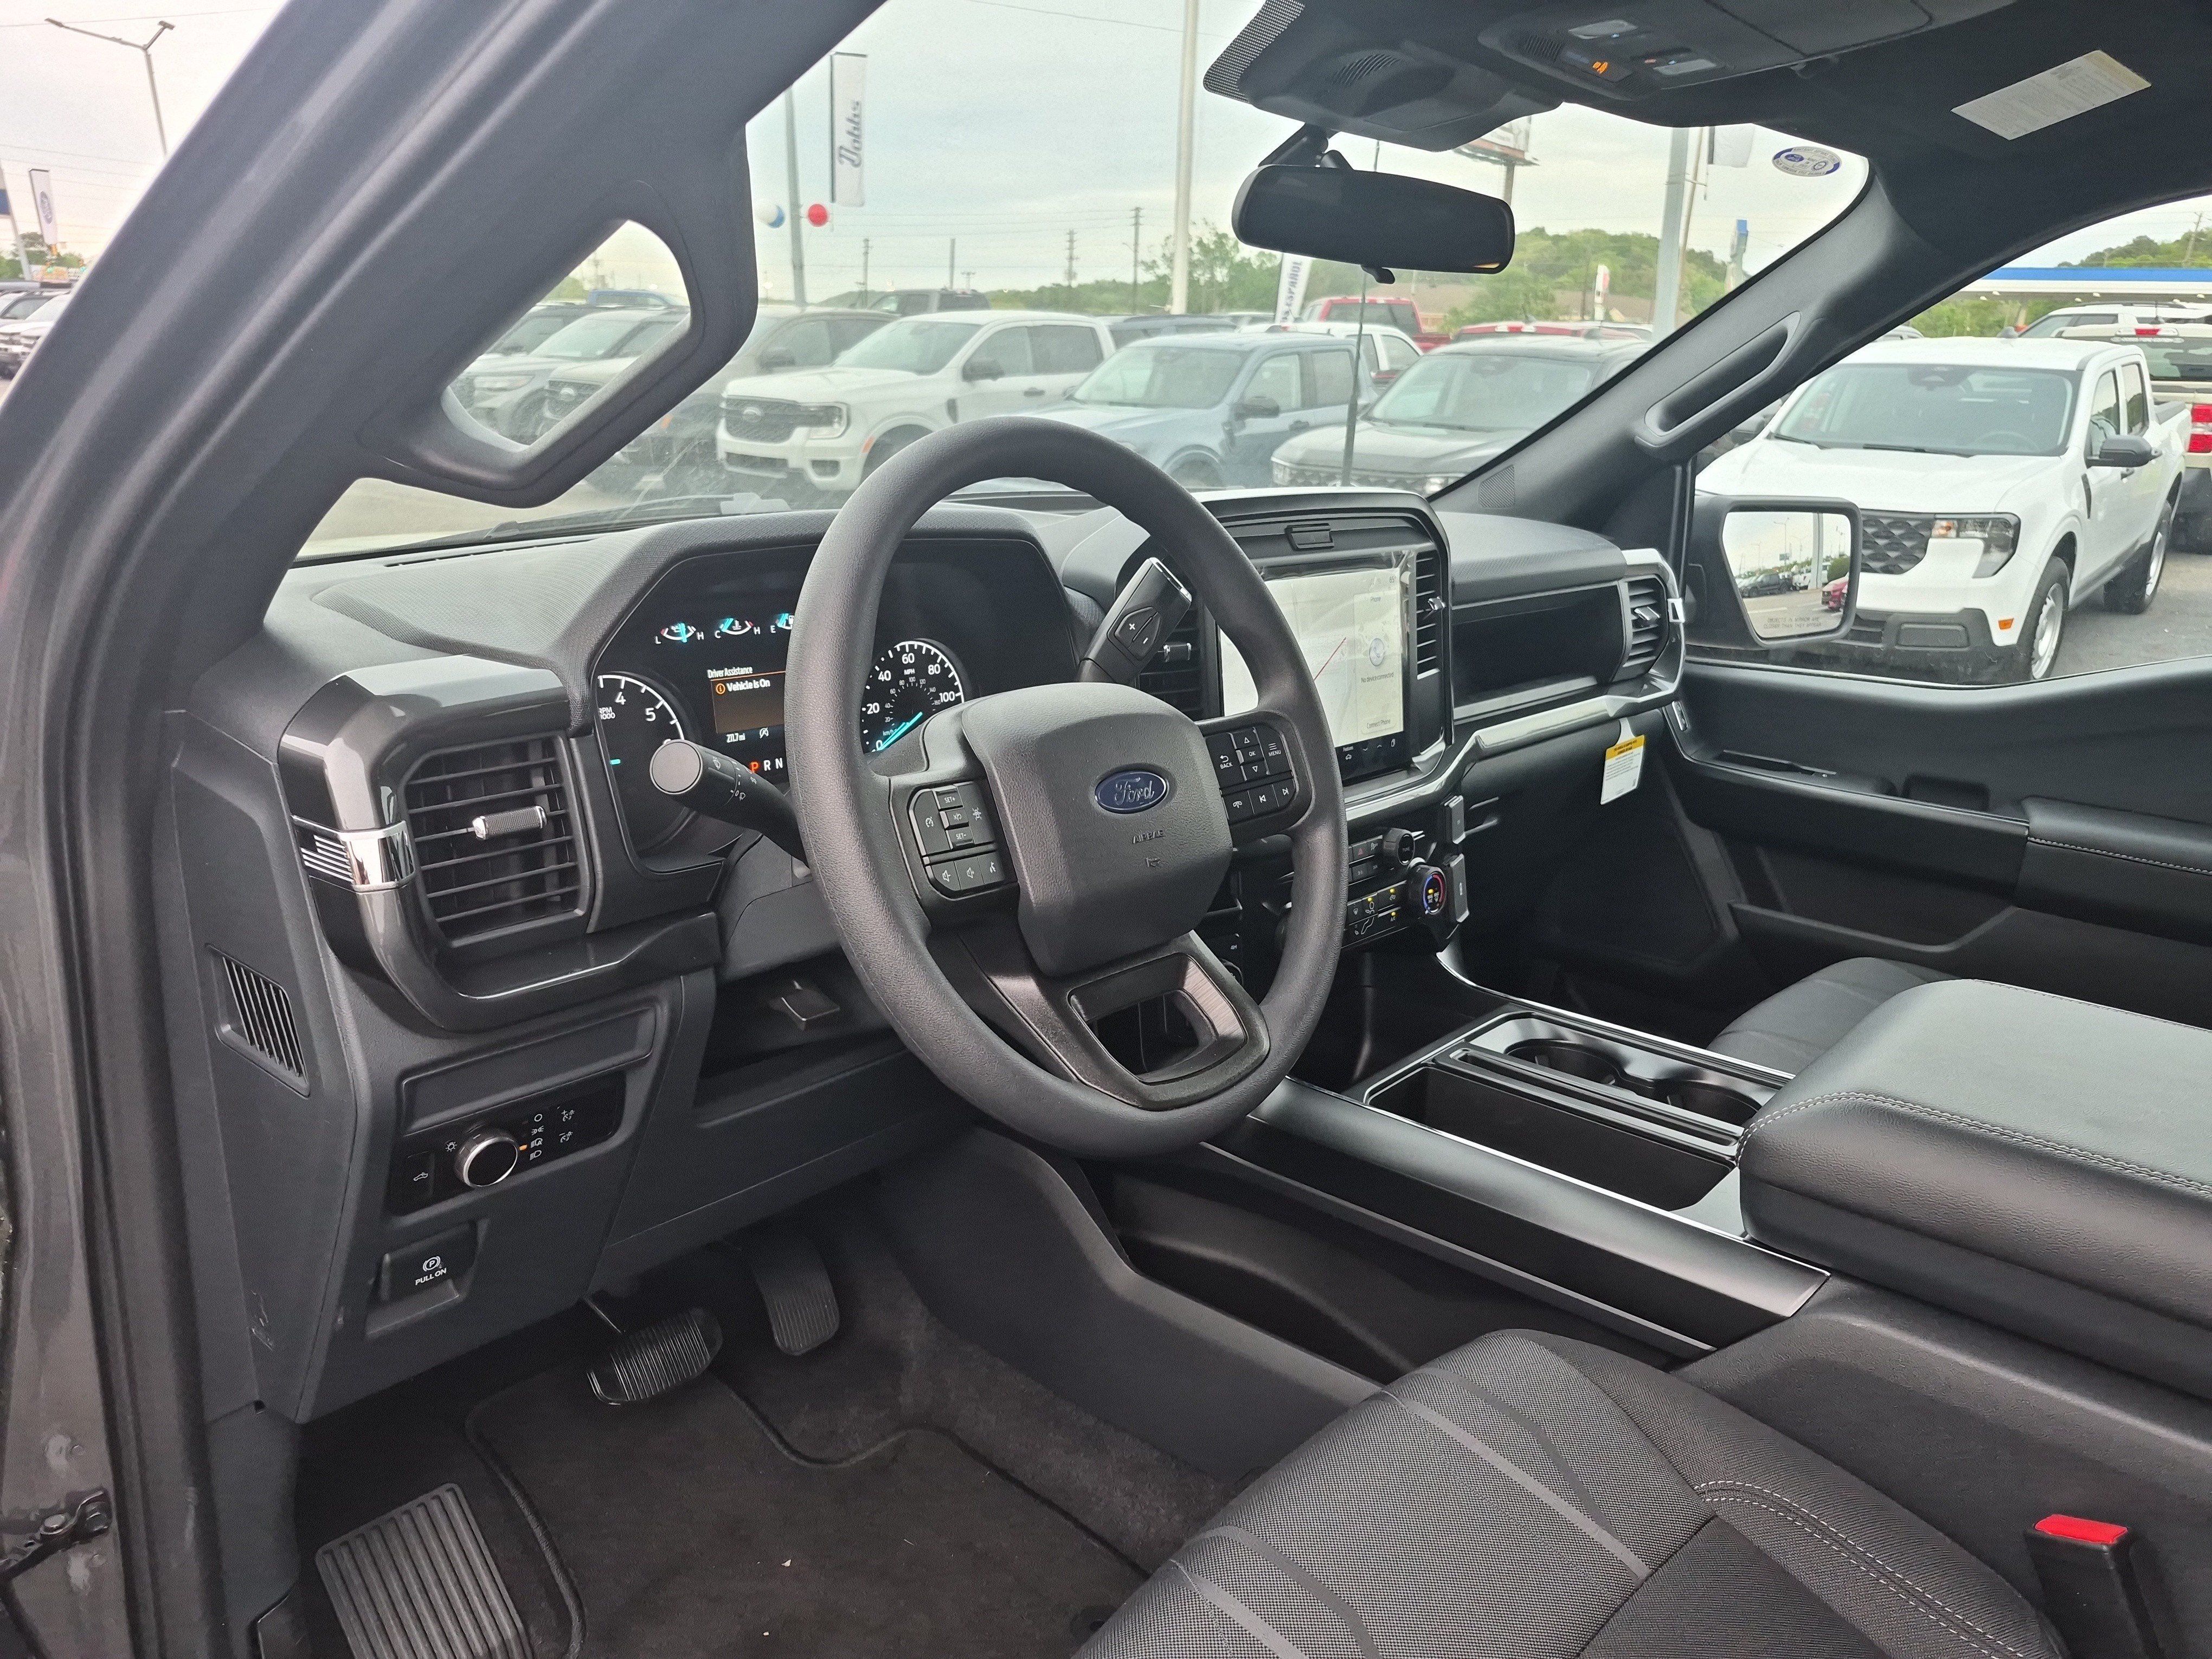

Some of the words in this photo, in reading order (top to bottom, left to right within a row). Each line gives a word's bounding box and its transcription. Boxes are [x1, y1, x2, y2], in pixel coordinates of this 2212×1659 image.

[839, 101, 861, 168] Dobbs
[696, 632, 704, 640] H
[714, 630, 721, 639] C
[754, 627, 761, 635] H
[902, 653, 915, 664] 60
[707, 669, 724, 678] Driver
[724, 667, 753, 677] Assistance
[878, 670, 891, 681] 40
[928, 664, 941, 675] 80
[1366, 674, 1377, 683] device
[1377, 671, 1394, 681] connected
[726, 680, 753, 692] Vehicle
[760, 679, 770, 687] On
[615, 691, 626, 705] 4
[939, 691, 955, 703] 100
[866, 702, 880, 715] 20
[645, 708, 656, 722] 5
[1366, 721, 1380, 729] Connect
[876, 740, 883, 751] 0
[751, 762, 758, 773] P
[763, 760, 771, 771] R
[775, 757, 783, 769] N
[1114, 777, 1154, 806] Ford
[415, 1274, 435, 1285] PULL
[435, 1267, 447, 1277] ON
